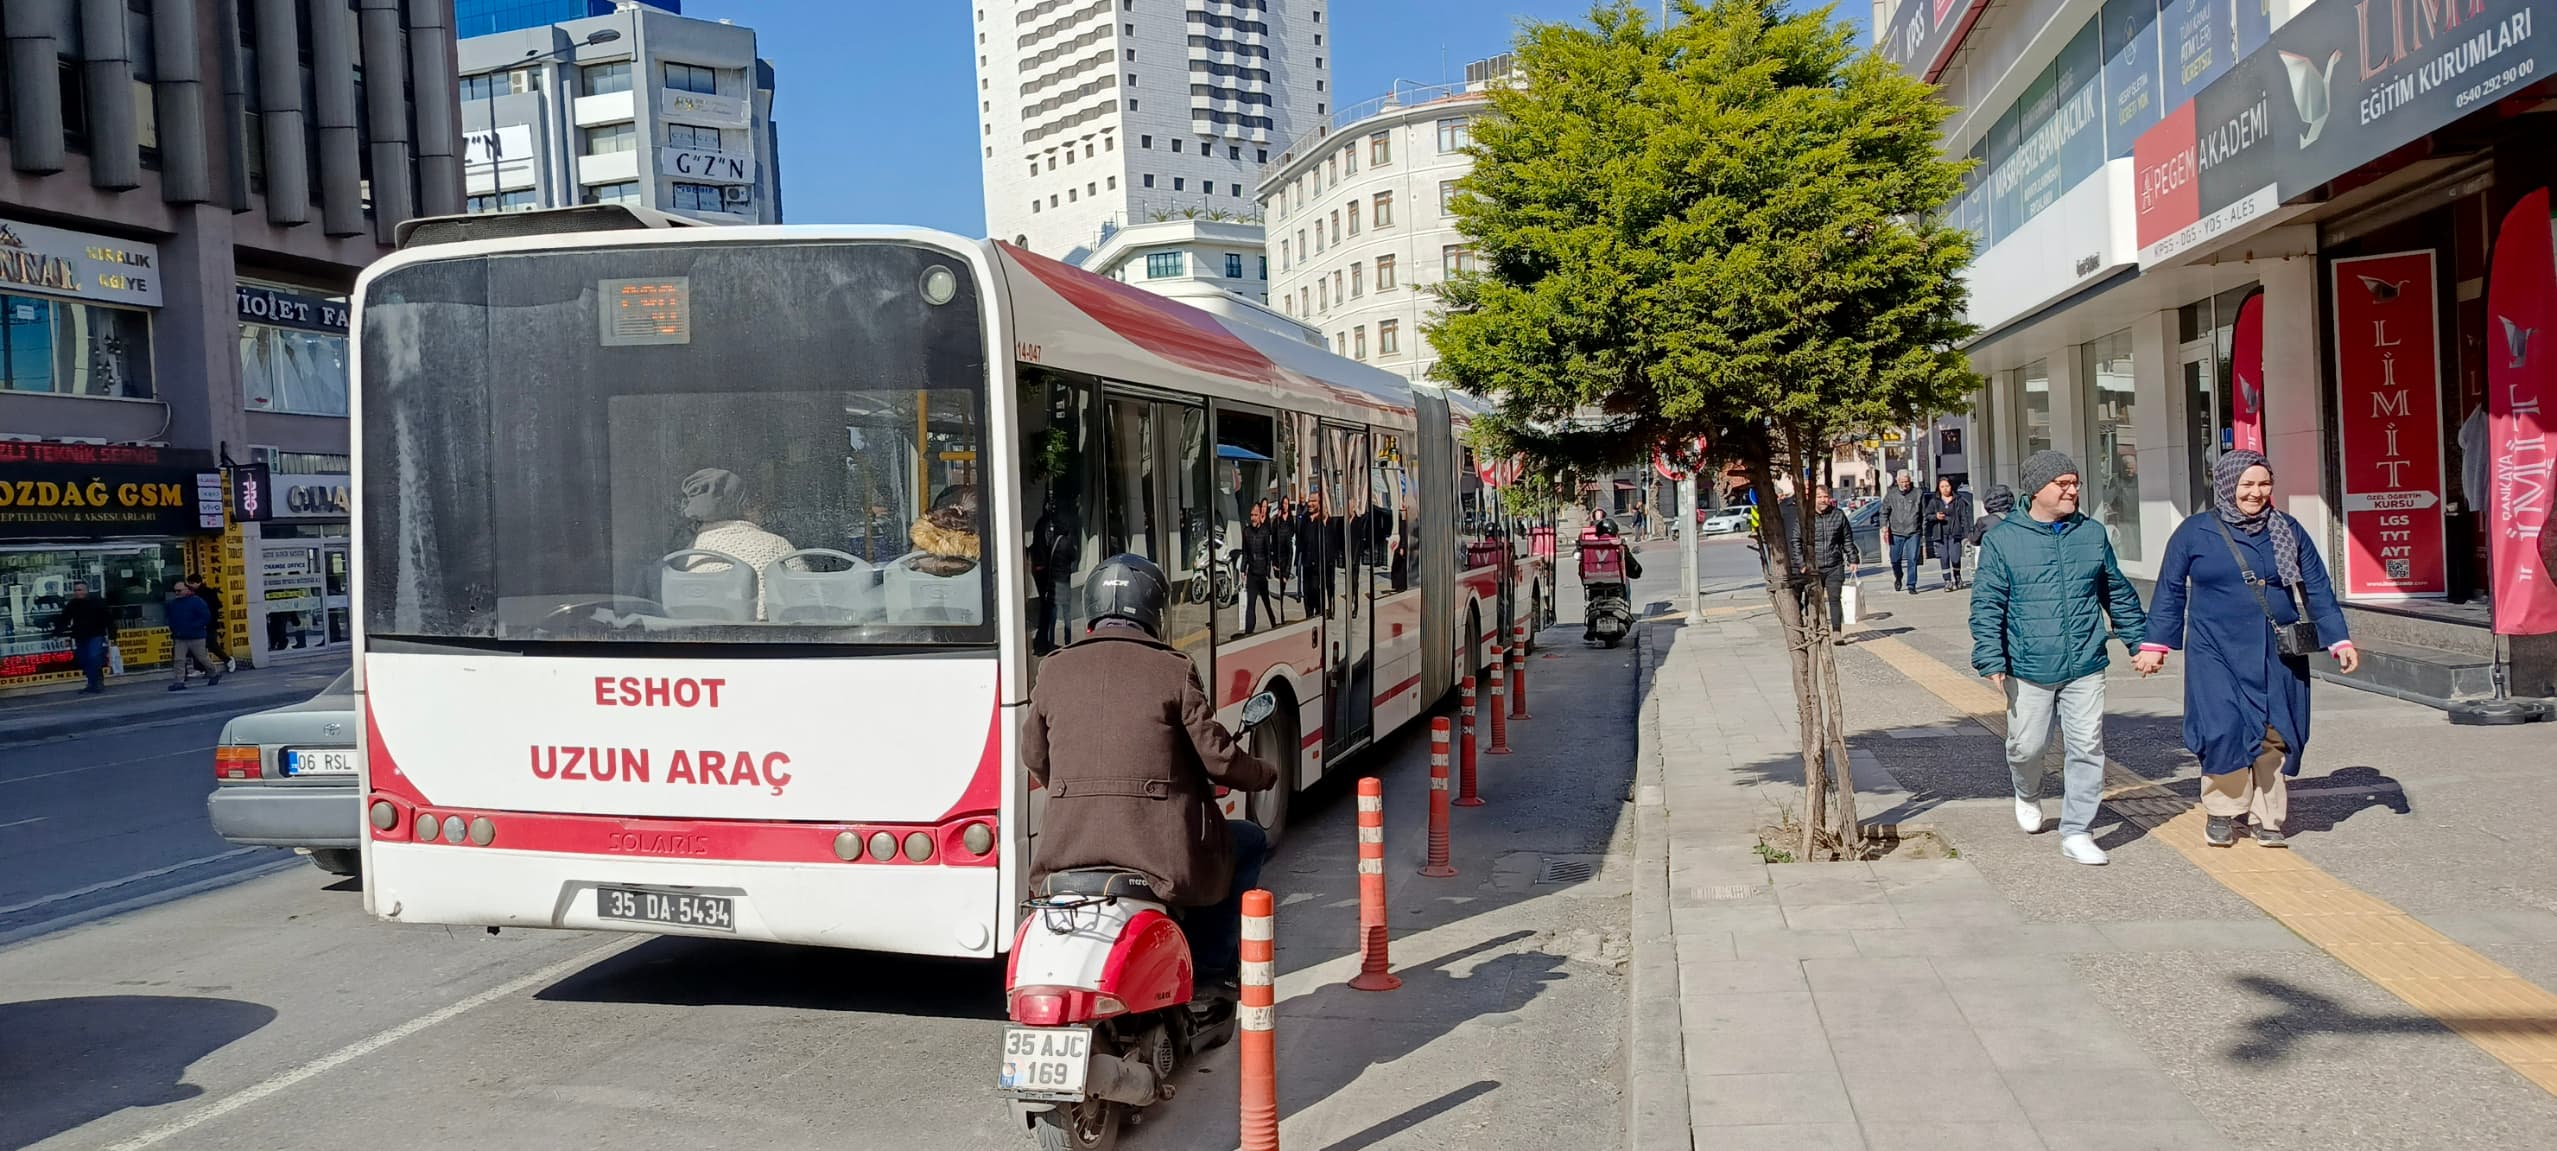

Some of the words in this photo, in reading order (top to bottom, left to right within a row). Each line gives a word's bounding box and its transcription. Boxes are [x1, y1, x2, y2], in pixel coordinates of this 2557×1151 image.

[1906, 2, 1924, 63] KPSS
[2360, 73, 2414, 125] EĞİTİM
[2419, 7, 2532, 94] KURUMLARI
[2456, 85, 2481, 108] 0540
[2483, 76, 2501, 96] 292
[2502, 67, 2517, 86] 90
[2518, 58, 2534, 79] 00
[1995, 137, 2038, 200] MASRAFSIZ
[2039, 84, 2096, 163] BANKACILIK
[2154, 145, 2195, 200] PEGEM
[2198, 90, 2268, 175] AKADEMİ
[2154, 242, 2174, 258] KPSS
[2181, 230, 2197, 246] DGS
[2204, 218, 2221, 234] YDS
[2231, 199, 2255, 224] ALES
[1018, 341, 1041, 363] 14-047
[2370, 320, 2412, 488] LİMİT
[118, 482, 184, 507] GSM
[2387, 492, 2421, 500] ÖĞRETİM
[2380, 515, 2409, 526] LGS
[2380, 530, 2410, 541] TYT
[2381, 546, 2411, 557] AYT
[595, 676, 725, 708] ESHOT
[299, 754, 315, 770] 06
[325, 754, 352, 770] RSL
[530, 745, 650, 783] UZUN
[666, 750, 792, 796] ARAÇ
[608, 832, 710, 856] SOLARIS
[611, 891, 635, 917] 35
[647, 894, 671, 920] DA
[680, 896, 730, 927] 5434
[1007, 1032, 1036, 1056] 35
[1041, 1034, 1084, 1058] AJC
[1028, 1062, 1068, 1085] 169
